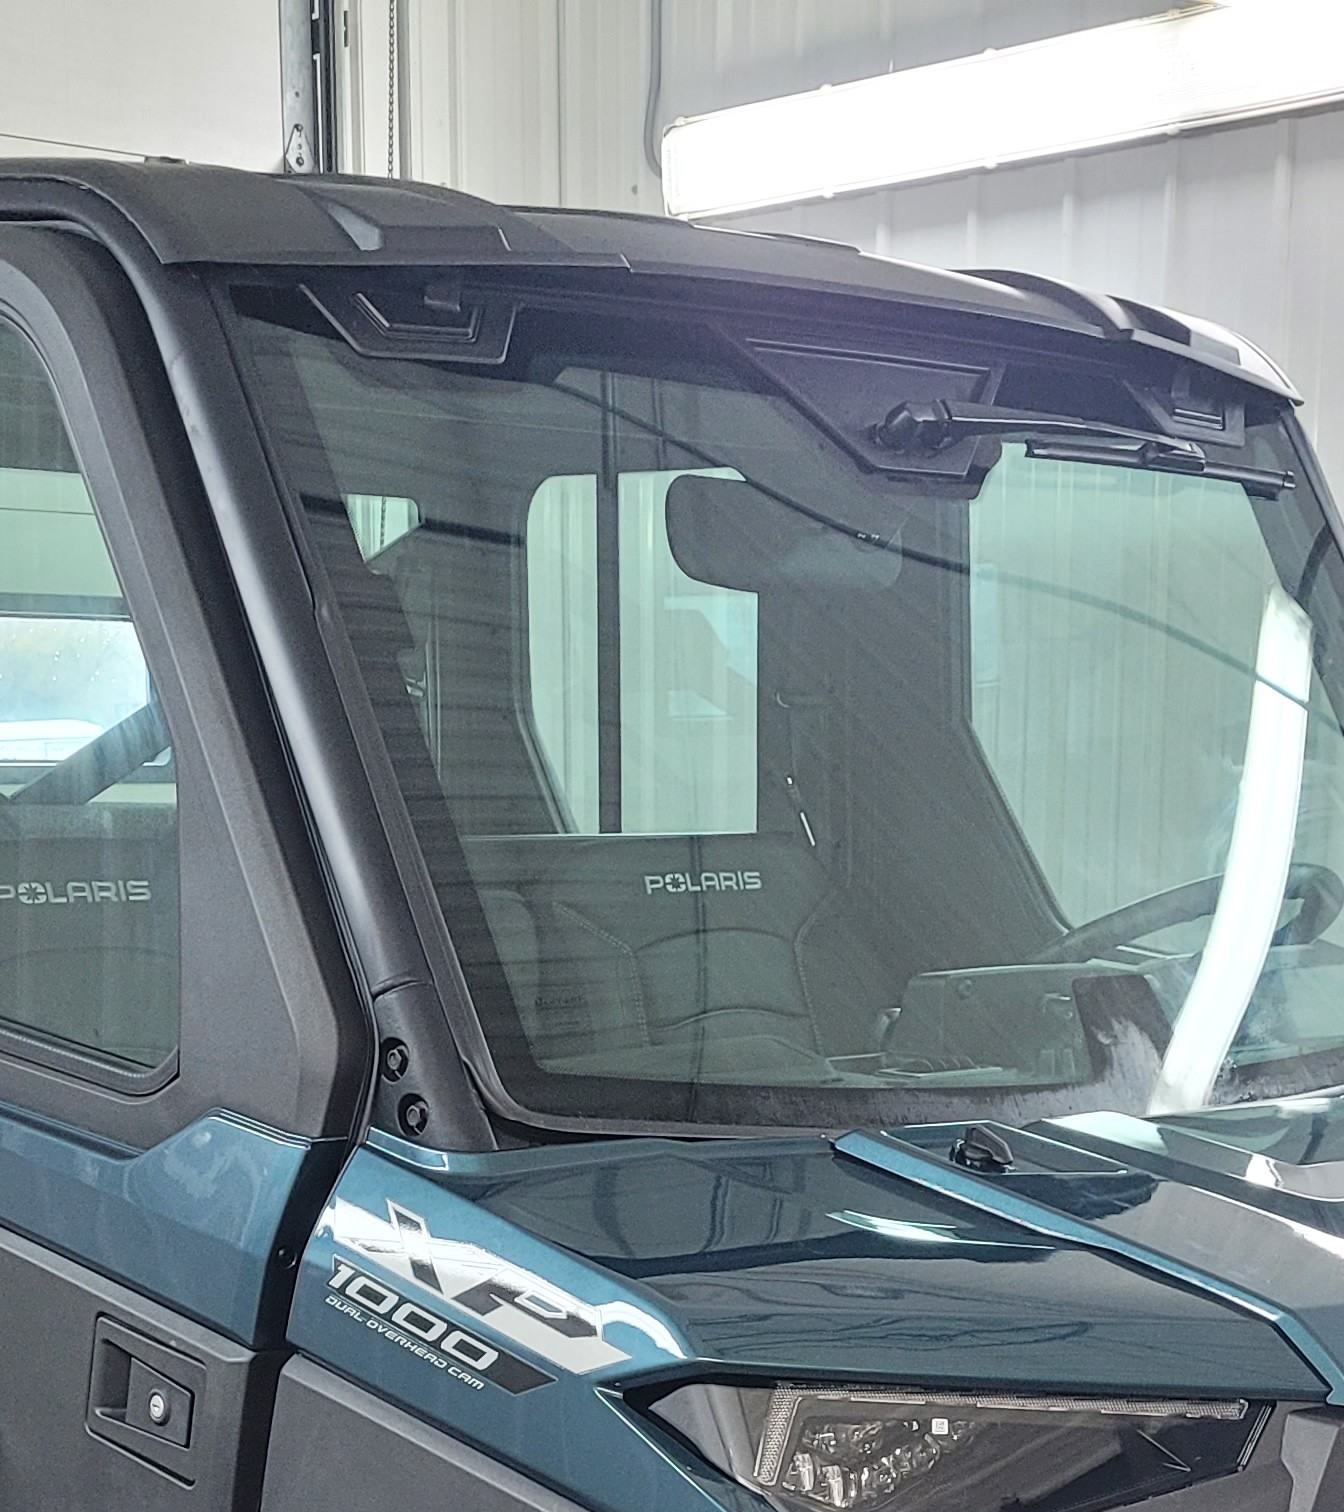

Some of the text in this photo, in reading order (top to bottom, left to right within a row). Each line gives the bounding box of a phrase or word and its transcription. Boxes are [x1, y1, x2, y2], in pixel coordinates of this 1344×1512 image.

[644, 870, 762, 895] POLARIS
[328, 1263, 499, 1371] 1000
[346, 1197, 605, 1341] XP
[325, 1294, 485, 1390] DUAL OVERHEAD CAM
